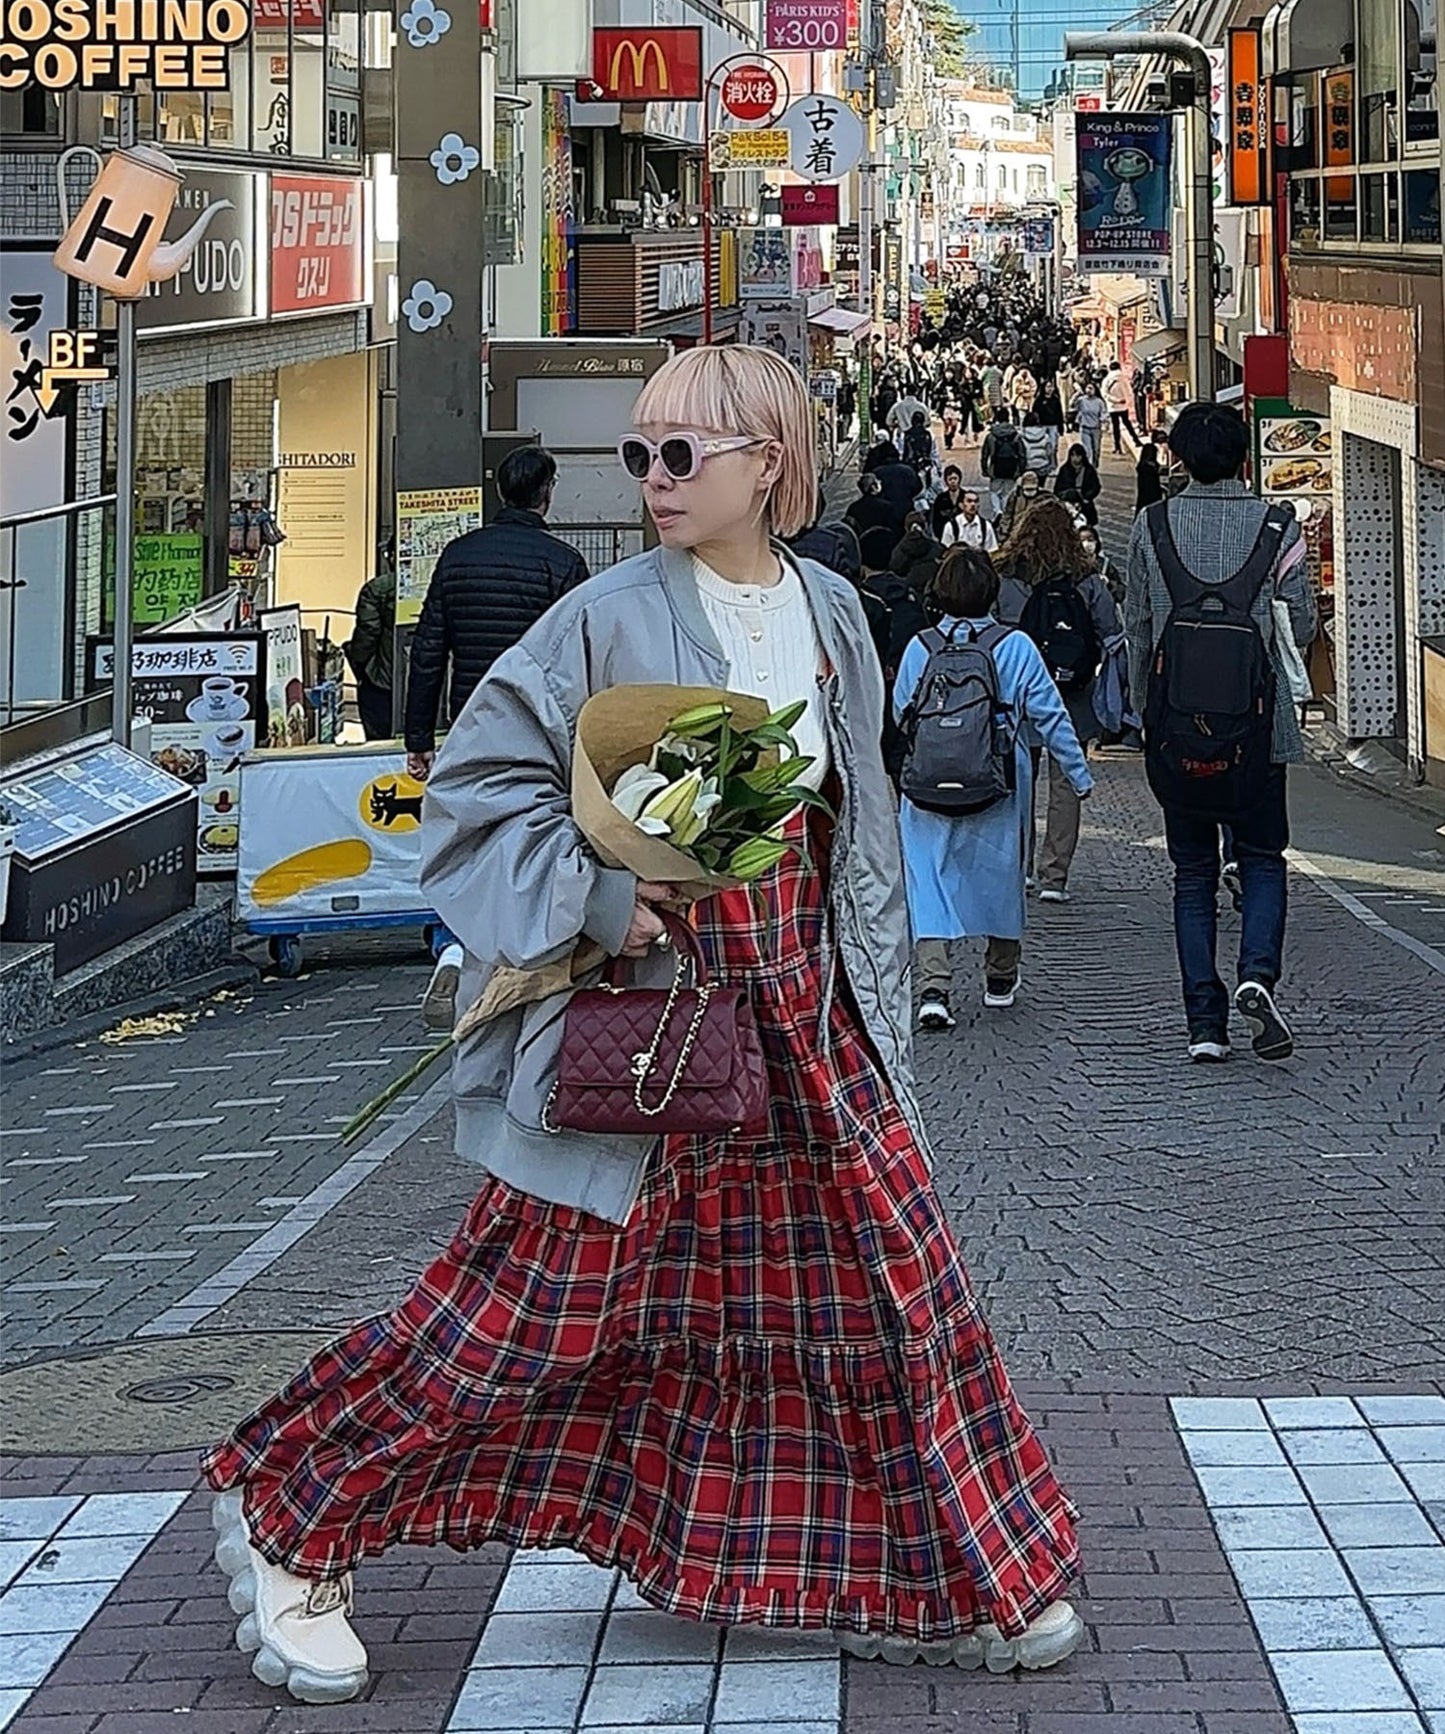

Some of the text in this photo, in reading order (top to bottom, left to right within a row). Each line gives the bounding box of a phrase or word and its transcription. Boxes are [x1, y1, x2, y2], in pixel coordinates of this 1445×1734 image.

[0, 0, 248, 42] OSHINO
[775, 4, 807, 17] PARIS
[774, 20, 839, 46] ¥300
[0, 43, 226, 88] COFFEE
[726, 82, 773, 103] 消火栓
[1086, 122, 1112, 133] King
[1113, 120, 1122, 132] &
[1125, 122, 1160, 132] Prince
[1258, 84, 1267, 149] YOSHINOYA
[803, 99, 838, 175] 古着
[1093, 136, 1119, 149] Tyler
[174, 189, 209, 209] AMEN
[75, 197, 154, 279] H
[297, 257, 330, 298] クスリ
[6, 294, 44, 440] ラーメン
[51, 332, 98, 368] BF
[617, 358, 644, 373] 原宿
[400, 496, 479, 510] TAKESHITA STREET
[44, 845, 184, 936] HOSHINO COFFEE
